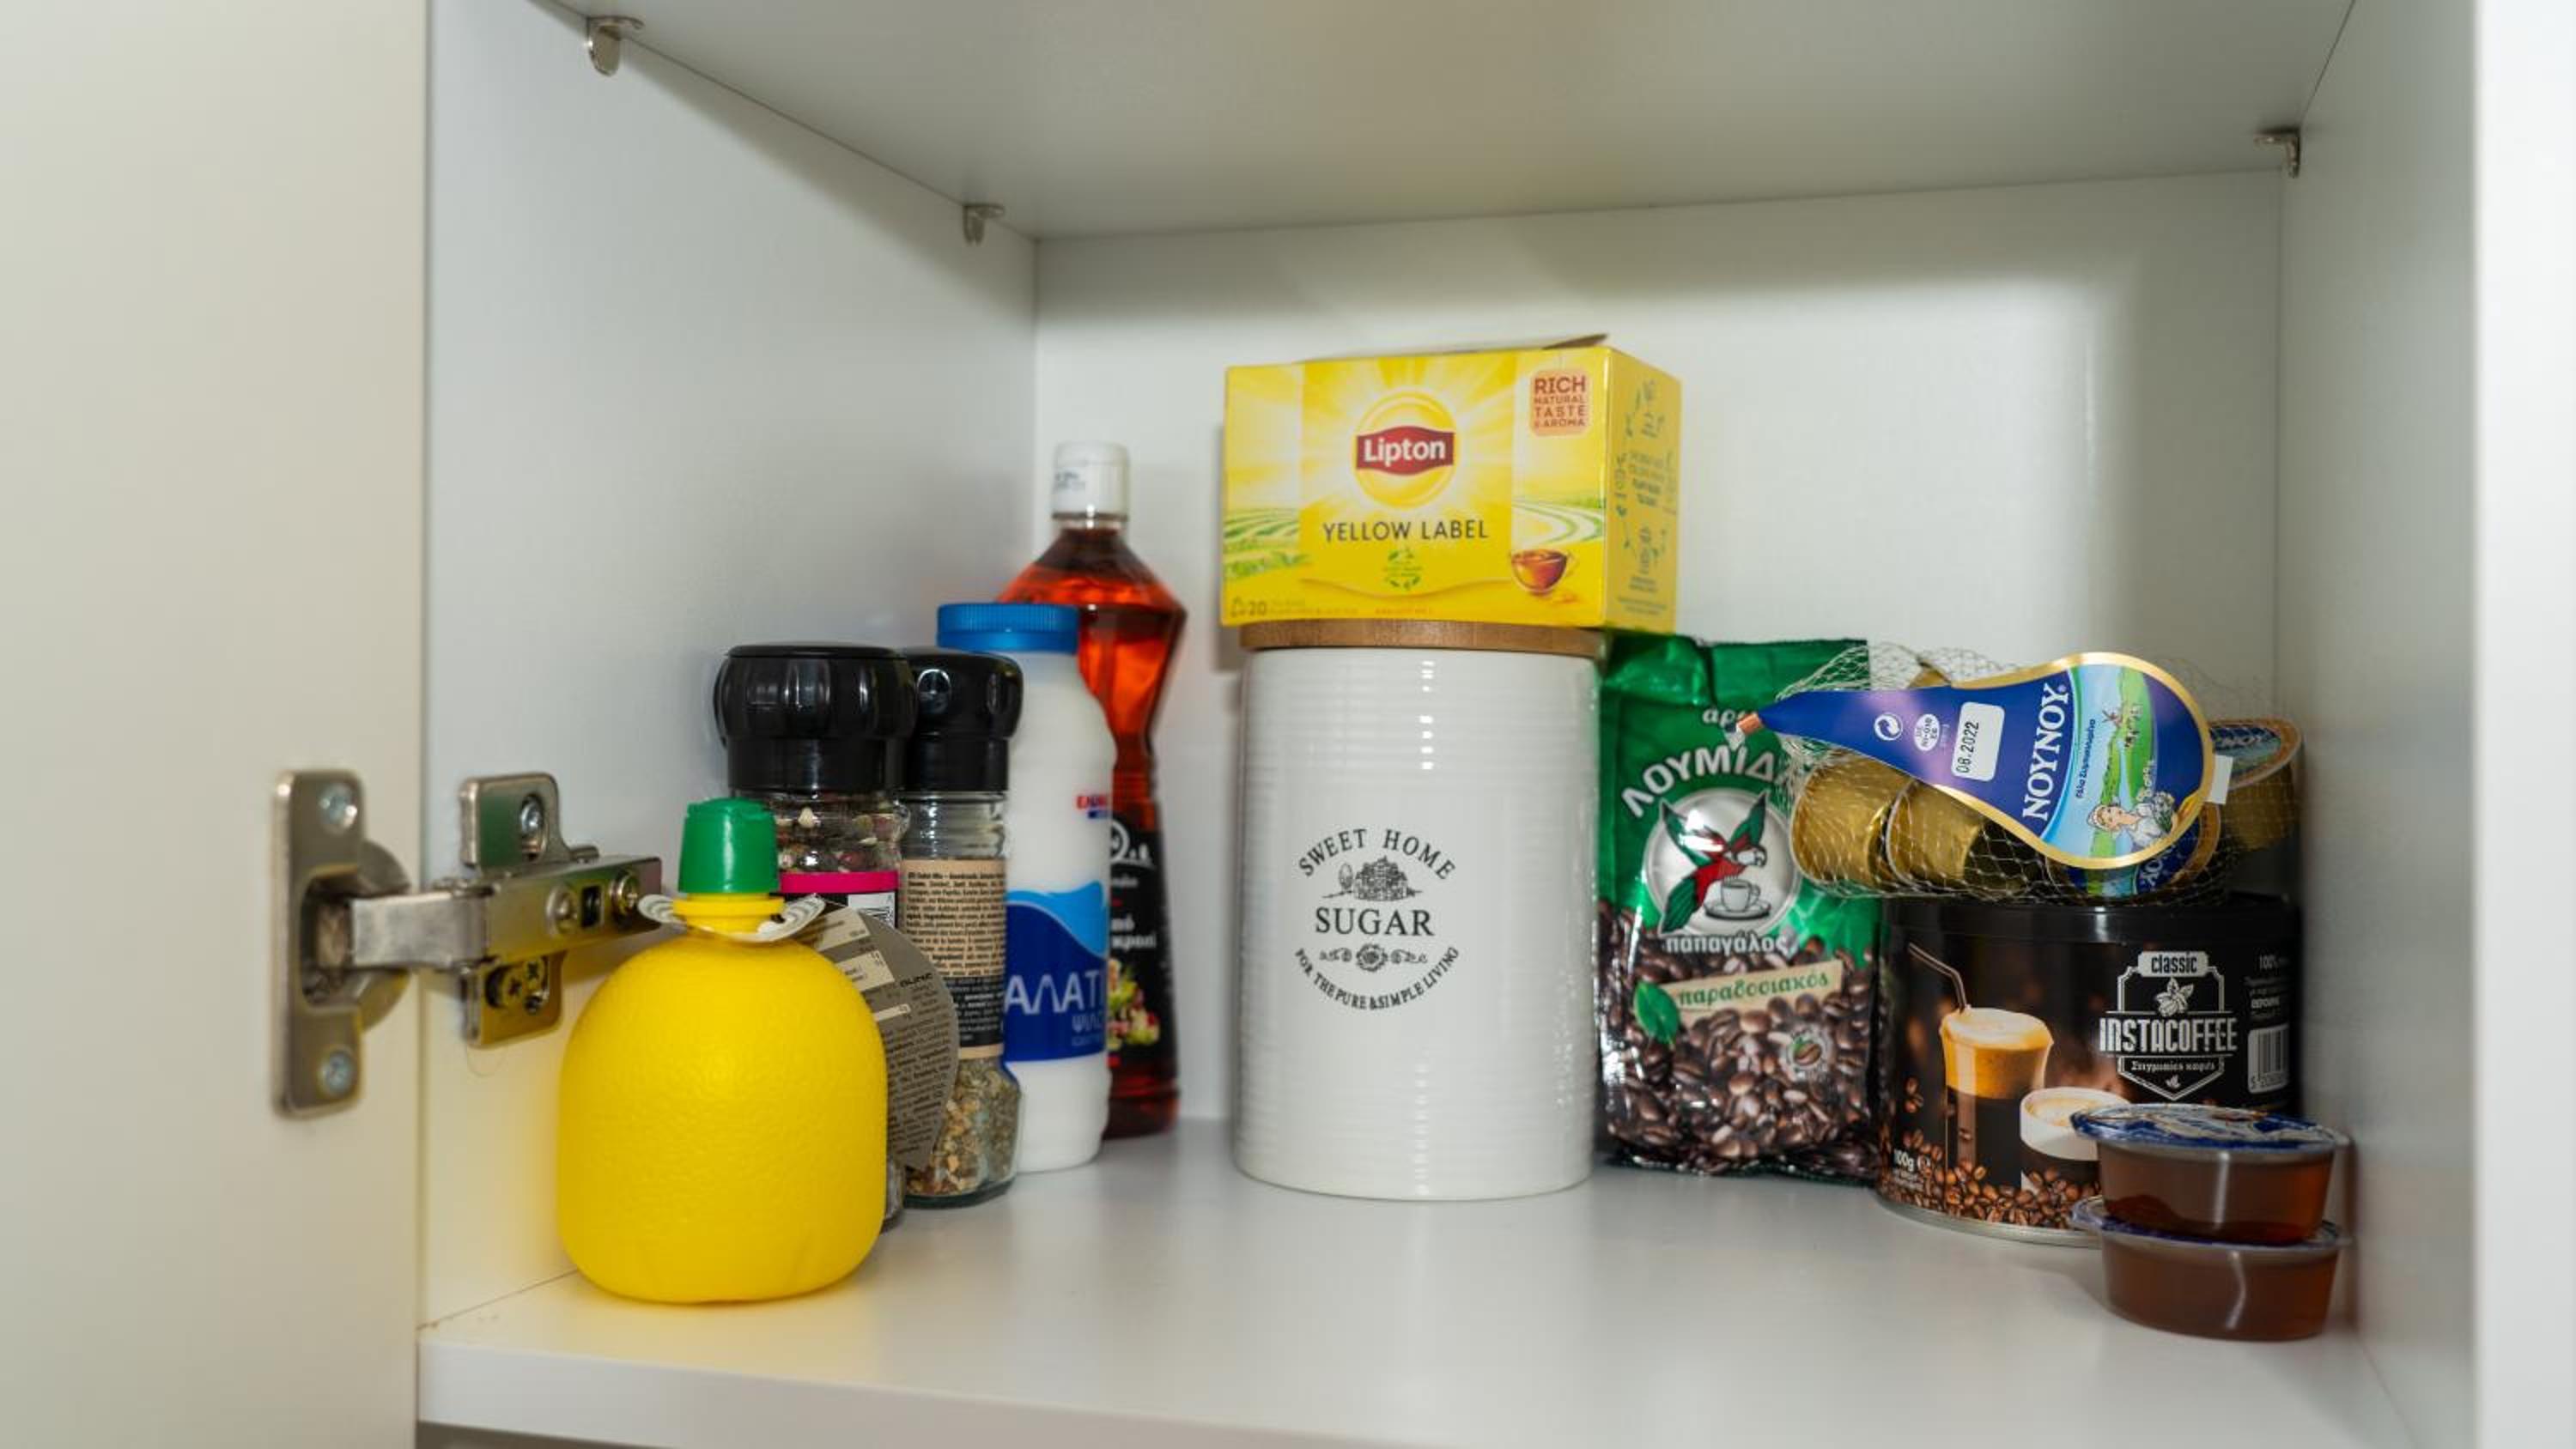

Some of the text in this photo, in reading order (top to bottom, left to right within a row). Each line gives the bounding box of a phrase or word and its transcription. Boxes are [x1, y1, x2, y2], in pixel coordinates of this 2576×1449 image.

[1534, 376, 1585, 393] RICH
[1535, 405, 1585, 417] TASTE
[1364, 438, 1445, 467] Lipton
[1322, 519, 1489, 543] YELLOW LABEL
[1955, 721, 1979, 773] 08.2022
[1621, 745, 1777, 818] ΛΟΥΜΙΔ
[1298, 828, 1456, 880] SWEET HOME
[1315, 906, 1436, 937] SUGAR
[1667, 930, 1798, 960] παπαγάλος
[1295, 948, 1314, 977] FOR
[1334, 988, 1367, 1010] PURE
[1423, 946, 1460, 988] LIVING
[2150, 955, 2197, 973] classic
[2099, 1017, 2239, 1052] INSTACOFFEE
